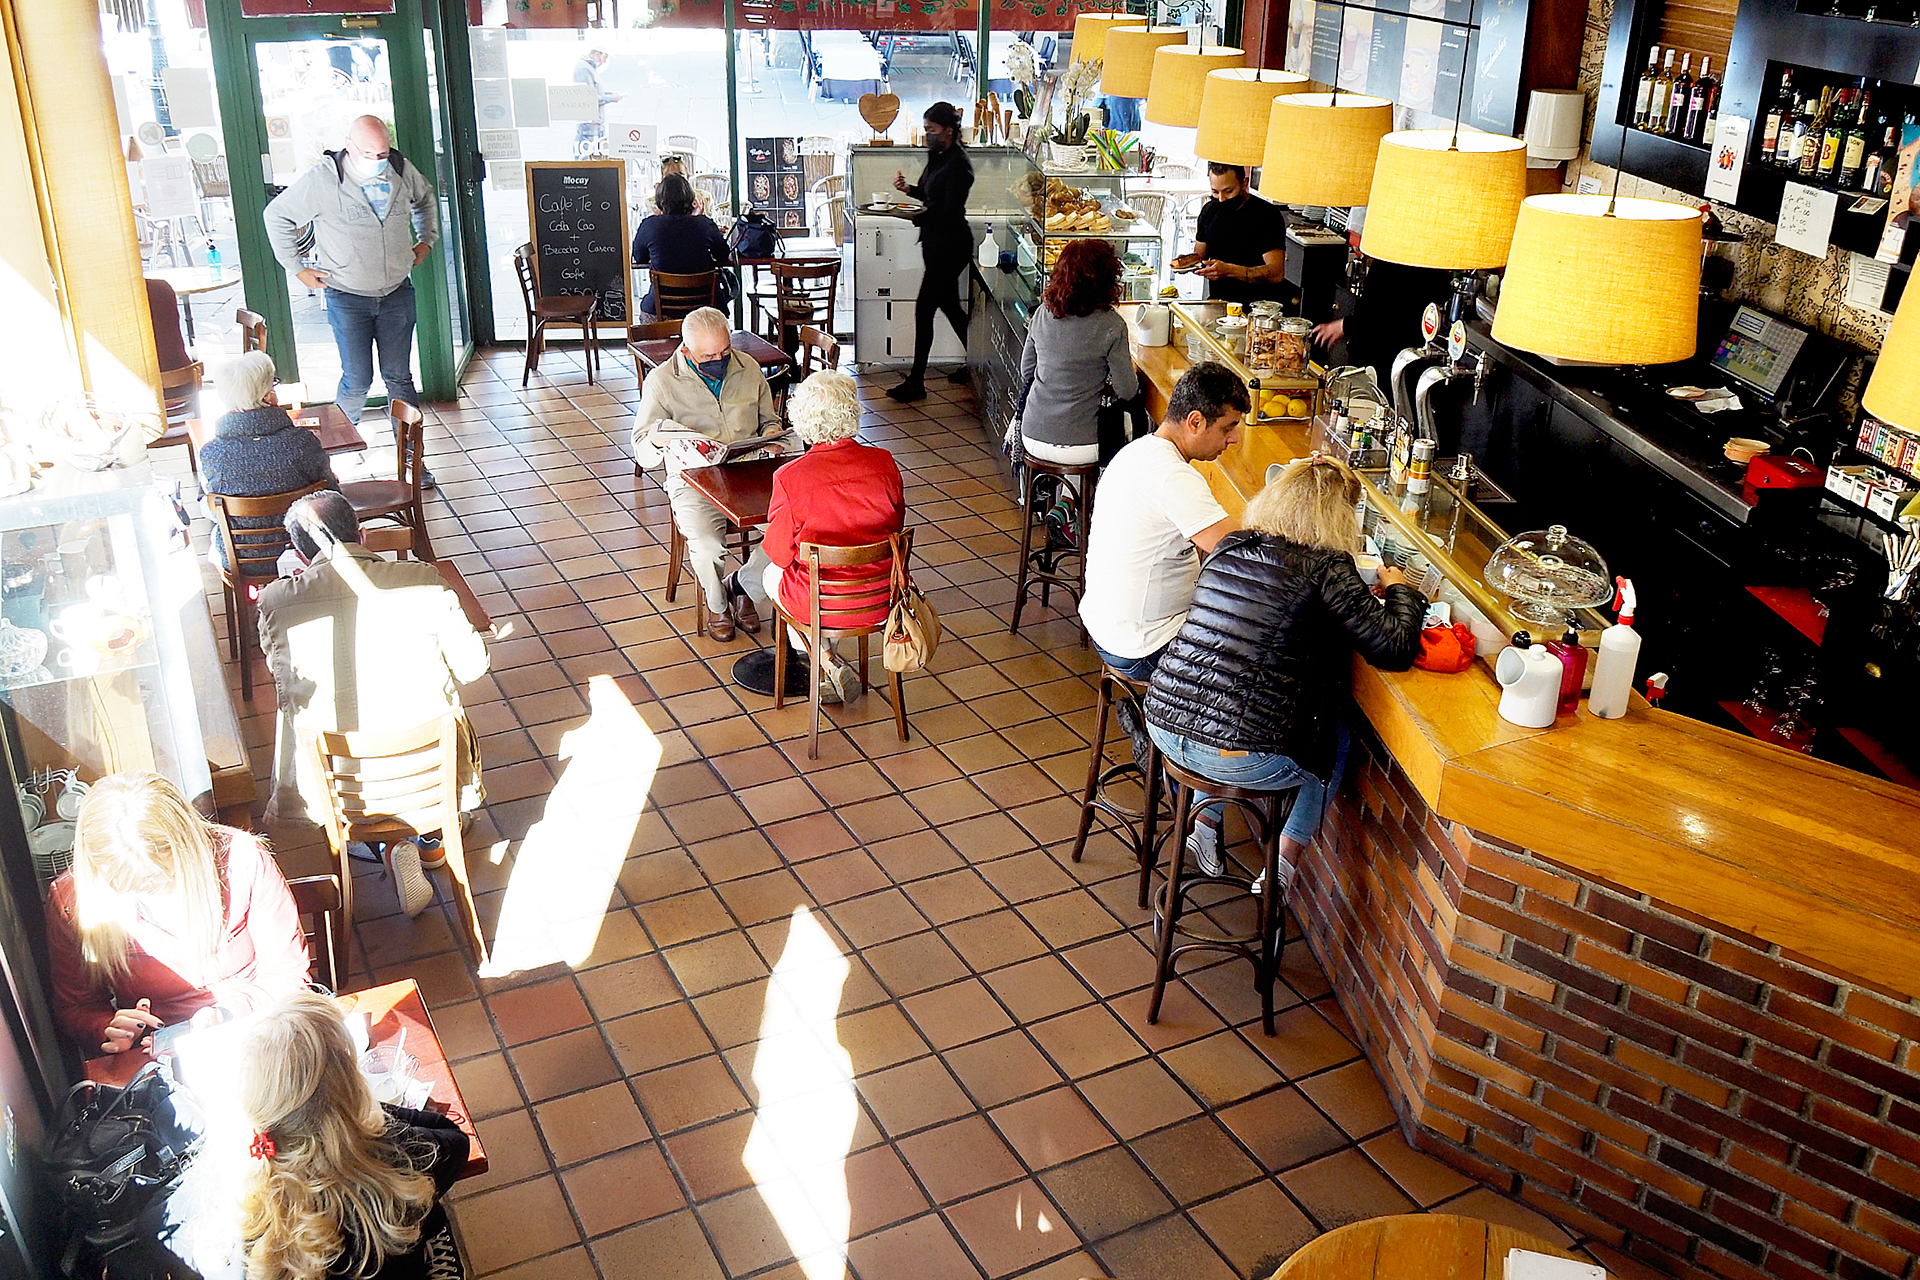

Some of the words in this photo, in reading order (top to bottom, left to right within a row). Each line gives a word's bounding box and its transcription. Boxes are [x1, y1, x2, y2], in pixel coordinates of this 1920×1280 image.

[563, 175, 590, 186] Mocay
[600, 201, 611, 211] o
[549, 220, 570, 232] Cola
[577, 218, 596, 232] Cao
[588, 240, 617, 253] Casero
